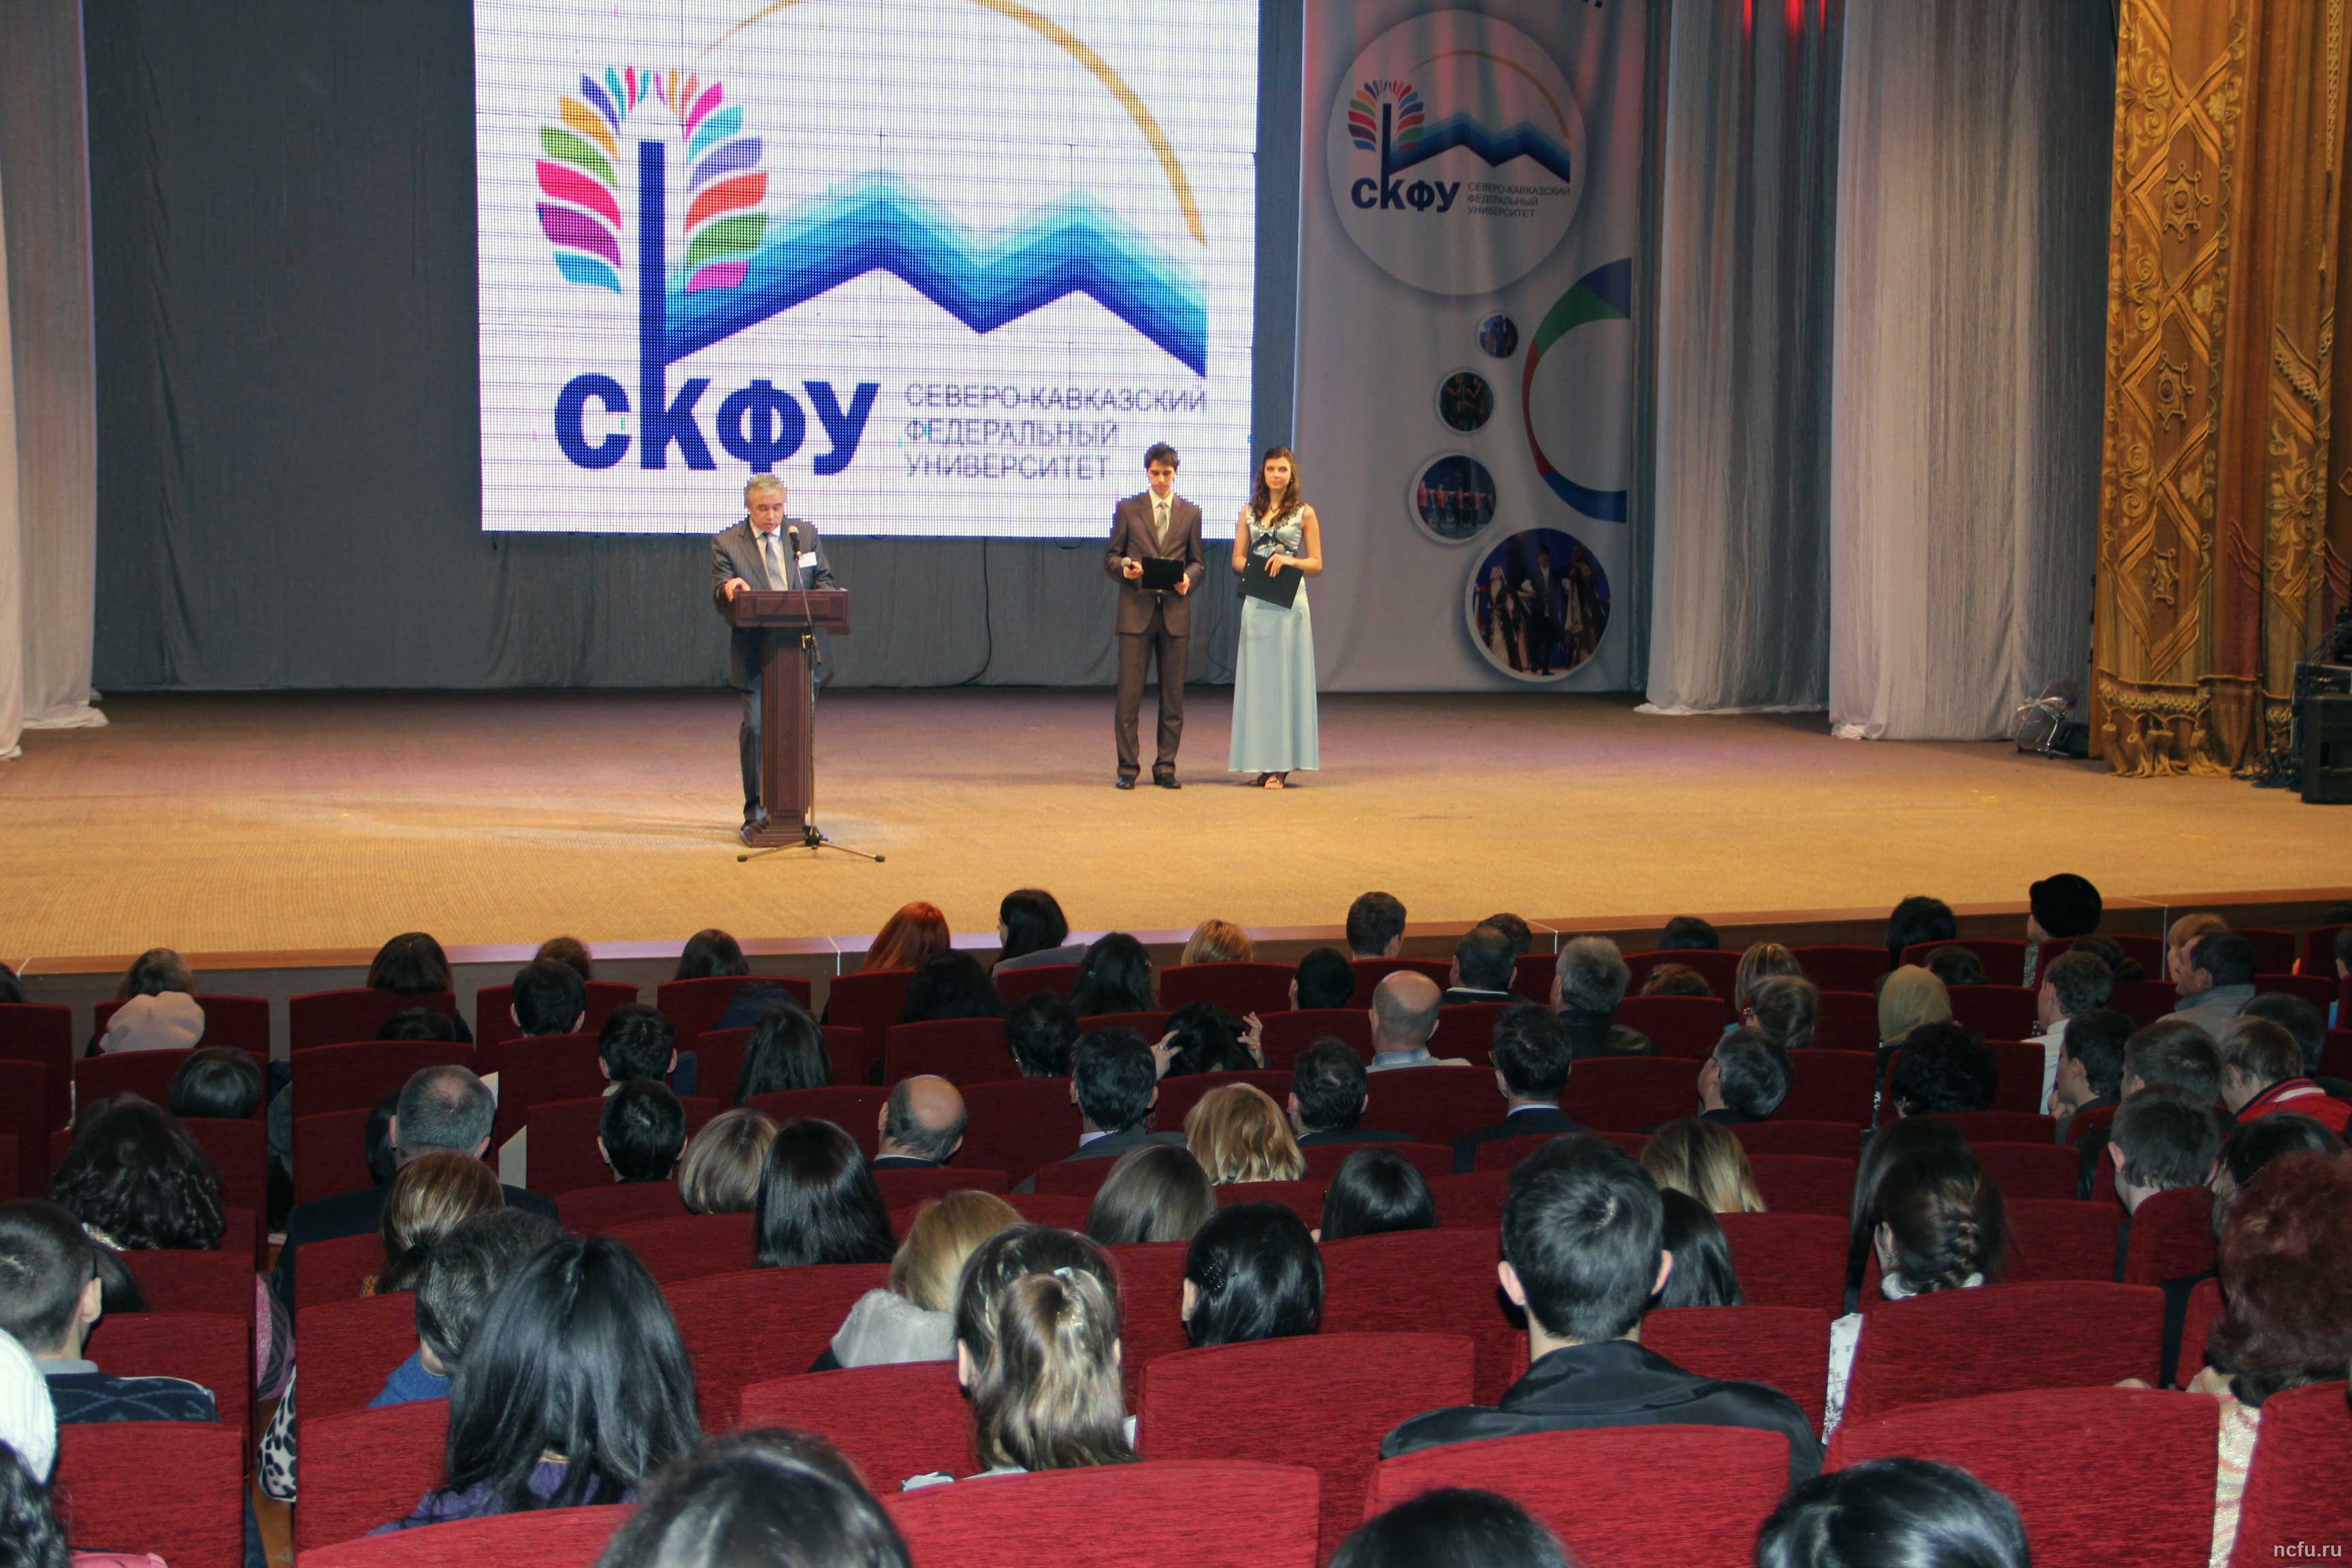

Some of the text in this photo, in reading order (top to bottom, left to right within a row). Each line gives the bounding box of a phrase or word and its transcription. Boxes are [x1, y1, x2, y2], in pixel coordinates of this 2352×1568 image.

[1351, 177, 1461, 213] СКФУ
[1468, 182, 1570, 196] СЕВЕРО-КАВКАЗСКИЙ
[1468, 195, 1539, 206] ФЕДЕРАЛЬНЫЙ
[1468, 206, 1535, 218] УНИВЕРСИТЕТ
[904, 383, 1208, 412] СЕВЕРО-КАВКАЗСКИЙ
[554, 372, 879, 475] СКФУ
[905, 418, 1120, 447] ФЕДЕРАЛЬНЫЙ
[905, 453, 1111, 480] УНИВЕРСИТЕТ
